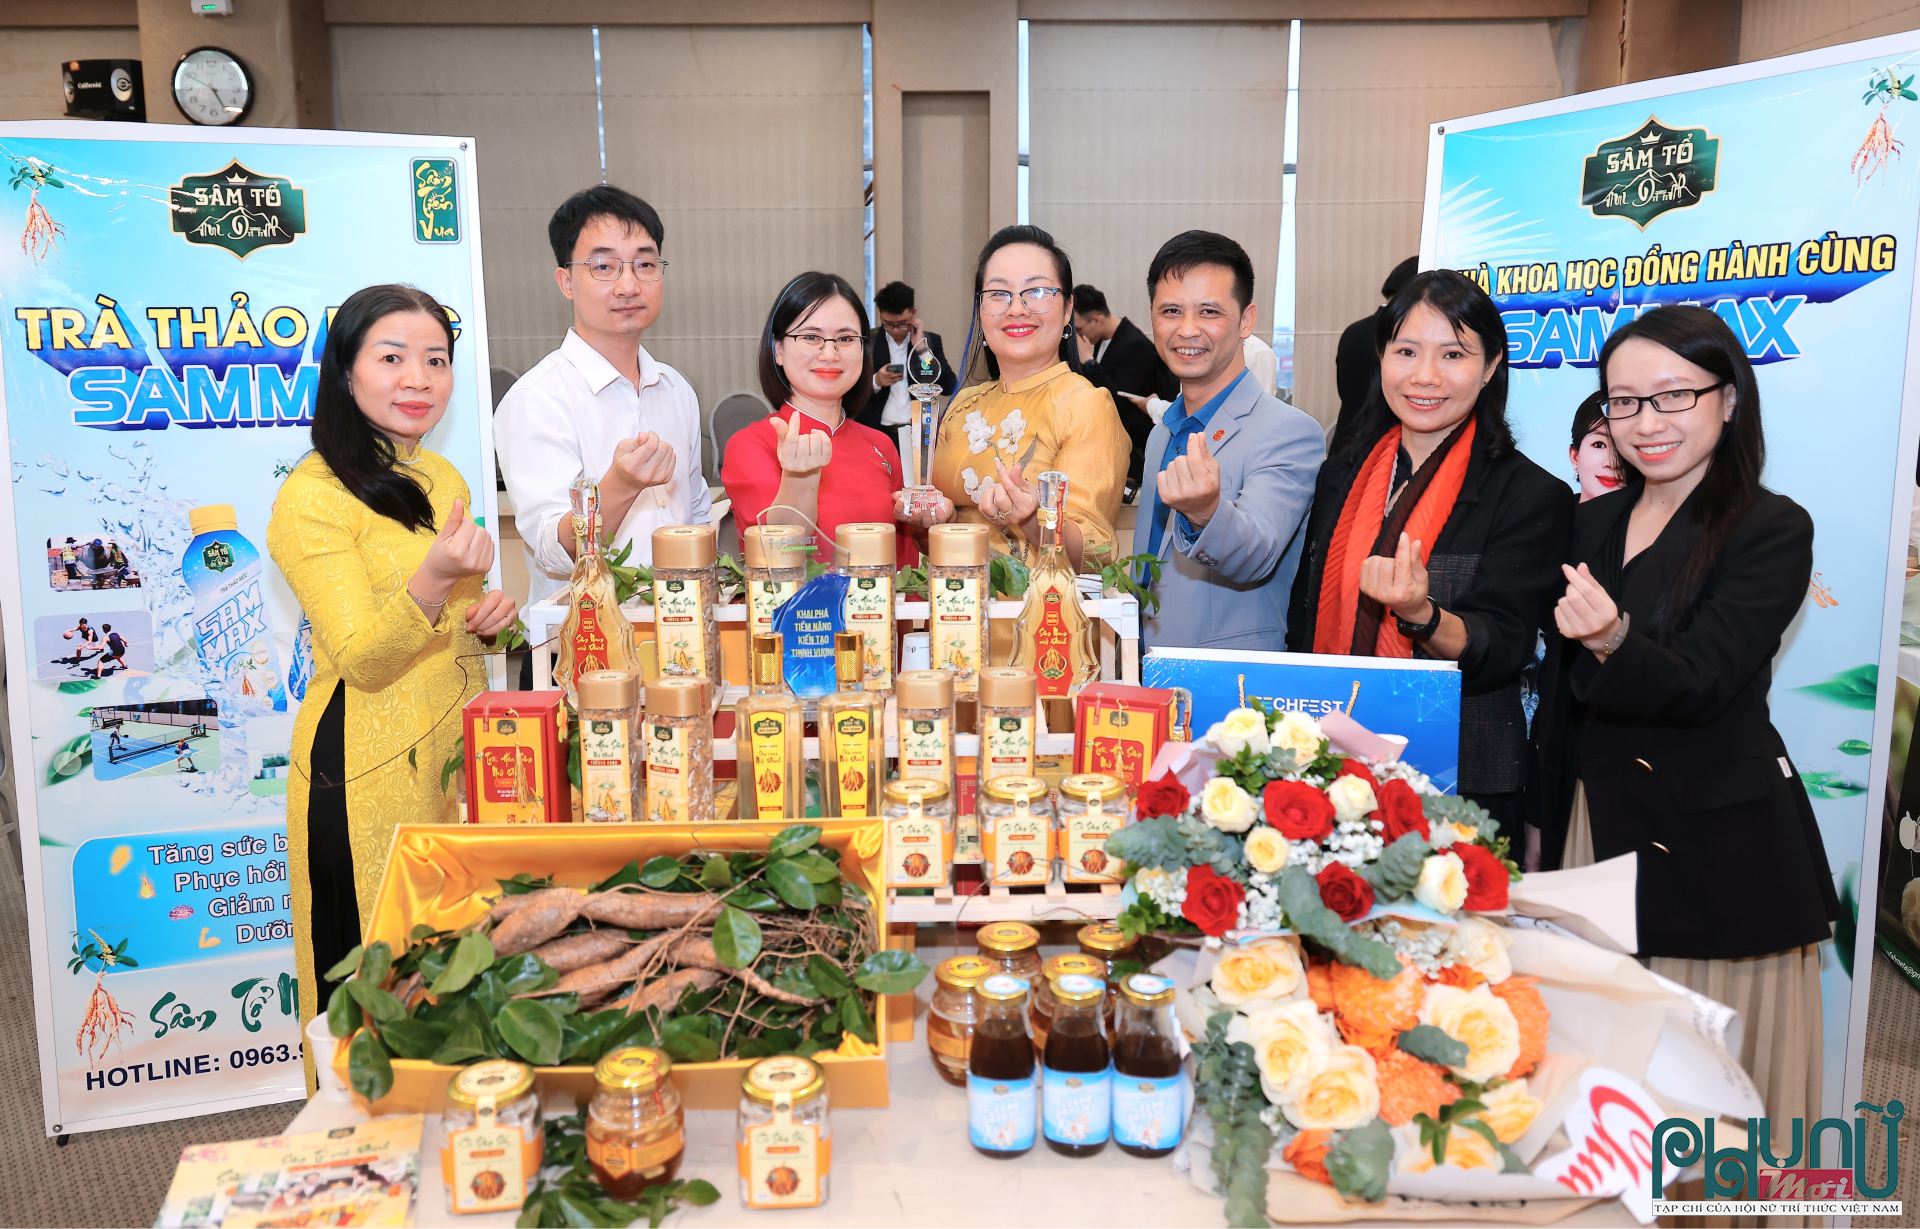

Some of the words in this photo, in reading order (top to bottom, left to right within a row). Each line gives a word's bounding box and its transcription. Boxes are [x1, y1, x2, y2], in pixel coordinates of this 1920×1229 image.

[205, 60, 217, 68] 12
[228, 72, 235, 81] 2
[1605, 146, 1654, 174] SÂM
[194, 183, 244, 206] SÂM
[418, 211, 455, 240] Vua
[1497, 262, 1560, 295] KHOA
[1565, 257, 1618, 298] HỌC
[1623, 243, 1702, 287] ĐỒNG
[1705, 240, 1793, 281] HÀNH
[1795, 231, 1897, 276] CÙNG
[16, 293, 134, 350] TRÀ
[147, 291, 309, 350] THẢO
[69, 364, 321, 425] SAMM
[924, 405, 932, 446] 2025
[196, 580, 262, 637] SAM
[200, 603, 267, 663] MAX
[147, 843, 214, 866] Tăng
[221, 835, 267, 859] sức
[174, 870, 240, 893] Phục
[247, 860, 287, 885] hồi
[208, 893, 275, 918] Giảm
[150, 992, 217, 1039] Sâm
[85, 1054, 221, 1091] HOTLINE:
